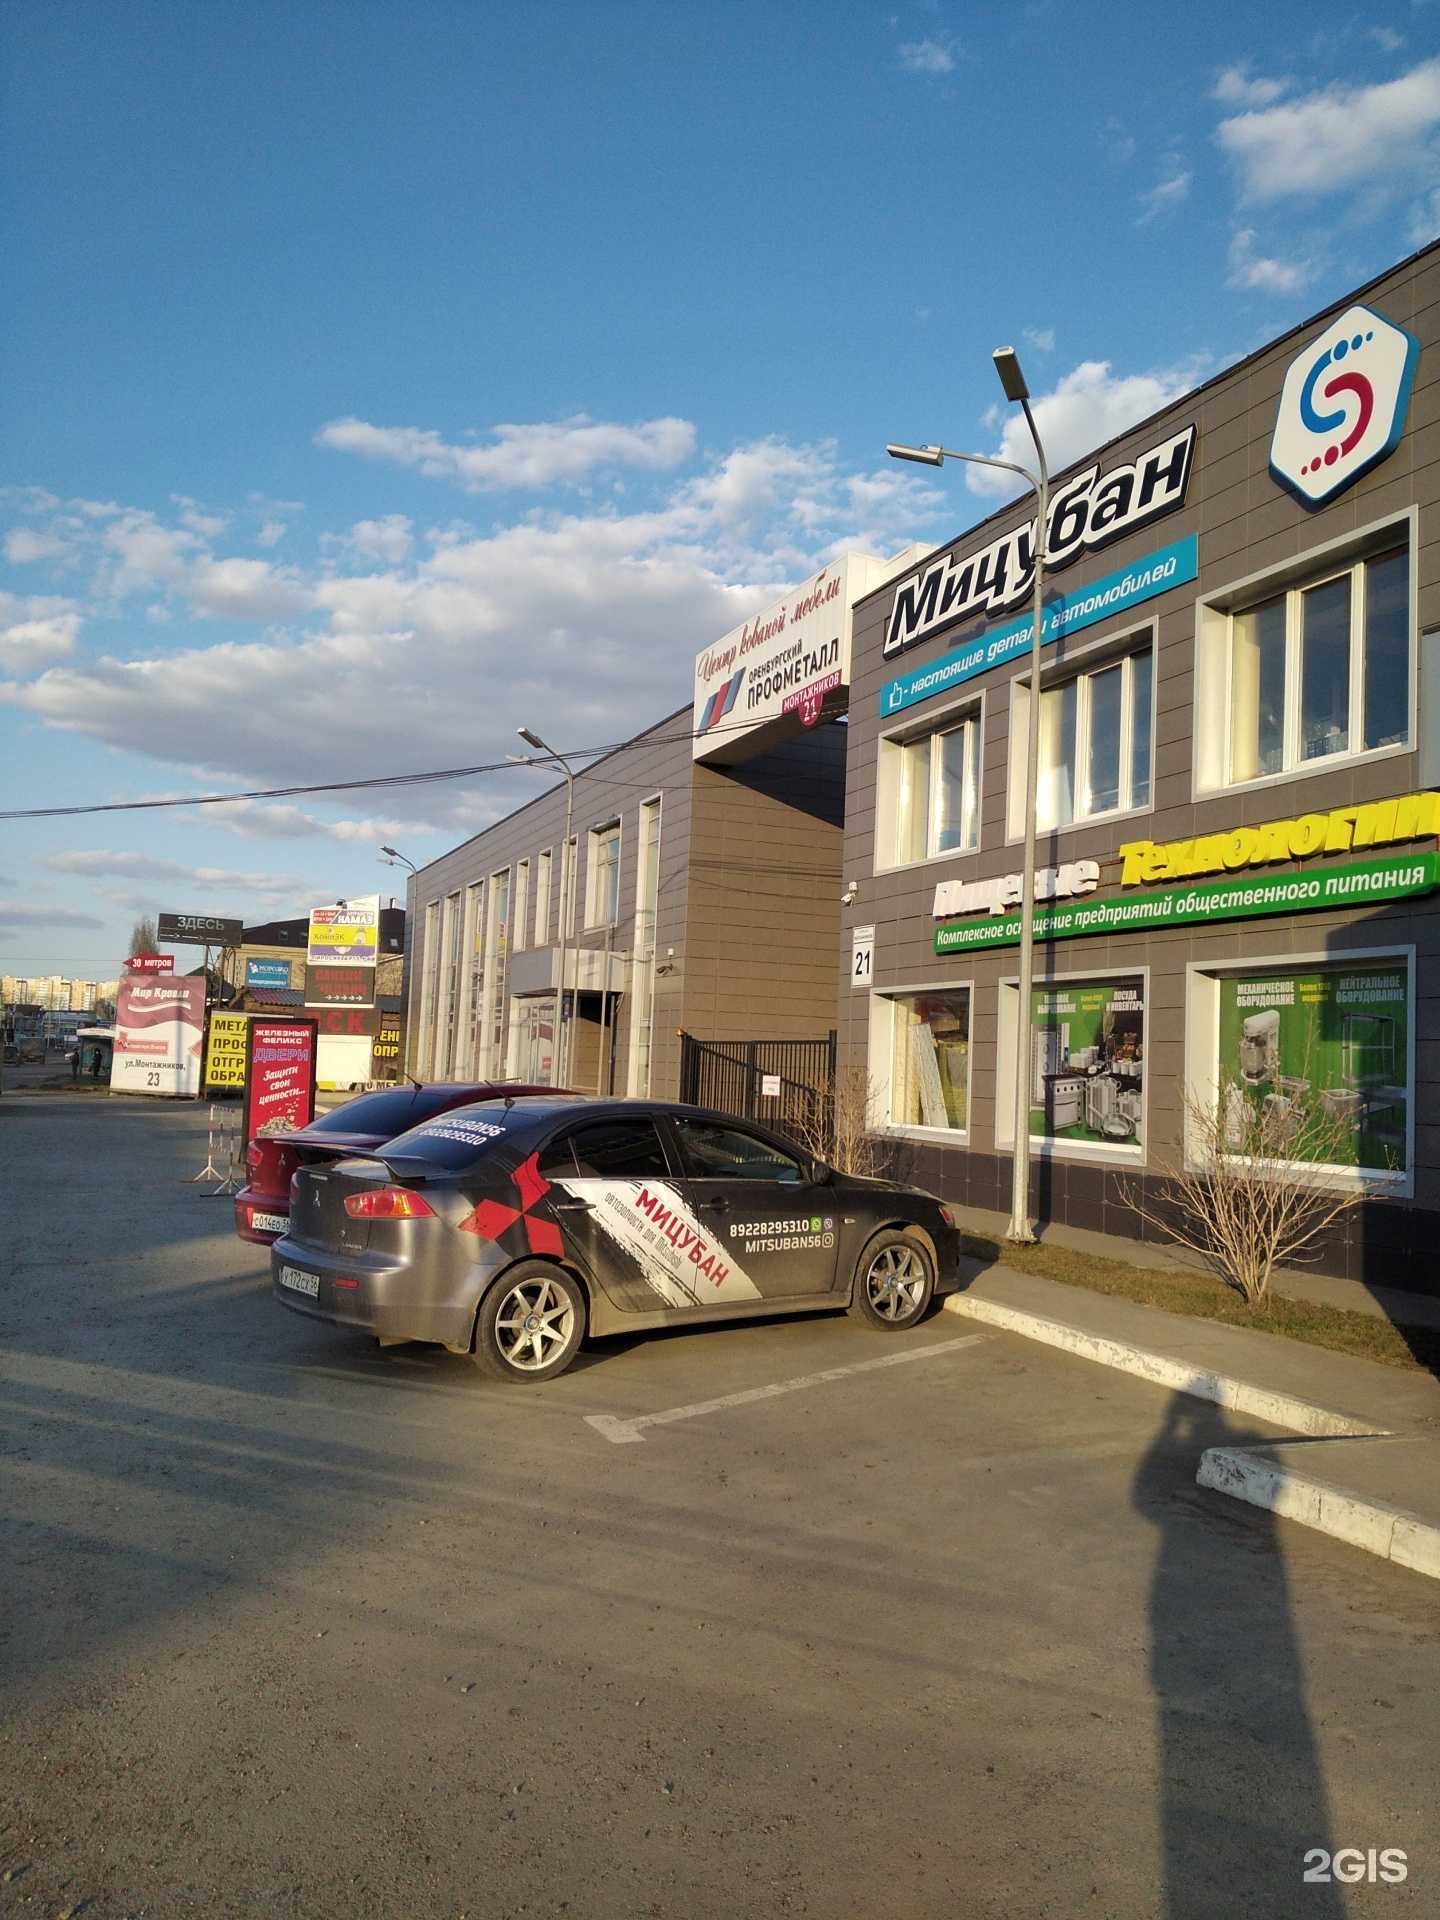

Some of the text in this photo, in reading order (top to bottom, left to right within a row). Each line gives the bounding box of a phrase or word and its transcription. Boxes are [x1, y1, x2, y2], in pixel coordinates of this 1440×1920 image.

[888, 434, 1192, 648] Мицубан
[697, 569, 841, 682] Центр кованой мебели
[910, 649, 985, 694] настоящие
[1050, 557, 1178, 630] автомобилей
[749, 638, 802, 683] ОРЕНБУРГСКИЙ
[747, 637, 839, 709] ПРОФМЕТАЛЛ
[783, 671, 840, 710] МОНТАЖНИКОВ
[804, 699, 817, 721] 21
[937, 865, 1426, 946] Комплексное оснщение предприятий общественного питания
[177, 916, 225, 931] ЗДЕСЬ
[132, 958, 172, 970] 30 метров
[855, 950, 870, 976] 21
[1237, 981, 1295, 995] МЕХАНИЧЕСКОЕ
[1339, 975, 1400, 990] НЕЙТРАЛЬНОЕ
[131, 987, 152, 998] Мир
[1236, 994, 1295, 1008] ОБОРУДОВАНИЕ
[1335, 989, 1405, 1004] ОБОРУДОВАНИЕ
[262, 1036, 303, 1045] ФЕЛИКС
[147, 1072, 160, 1087] 23
[263, 1065, 299, 1081] Защити
[270, 1079, 291, 1091] свои
[730, 1219, 809, 1238] 89228295310
[634, 1188, 729, 1289] МИЦУБАН
